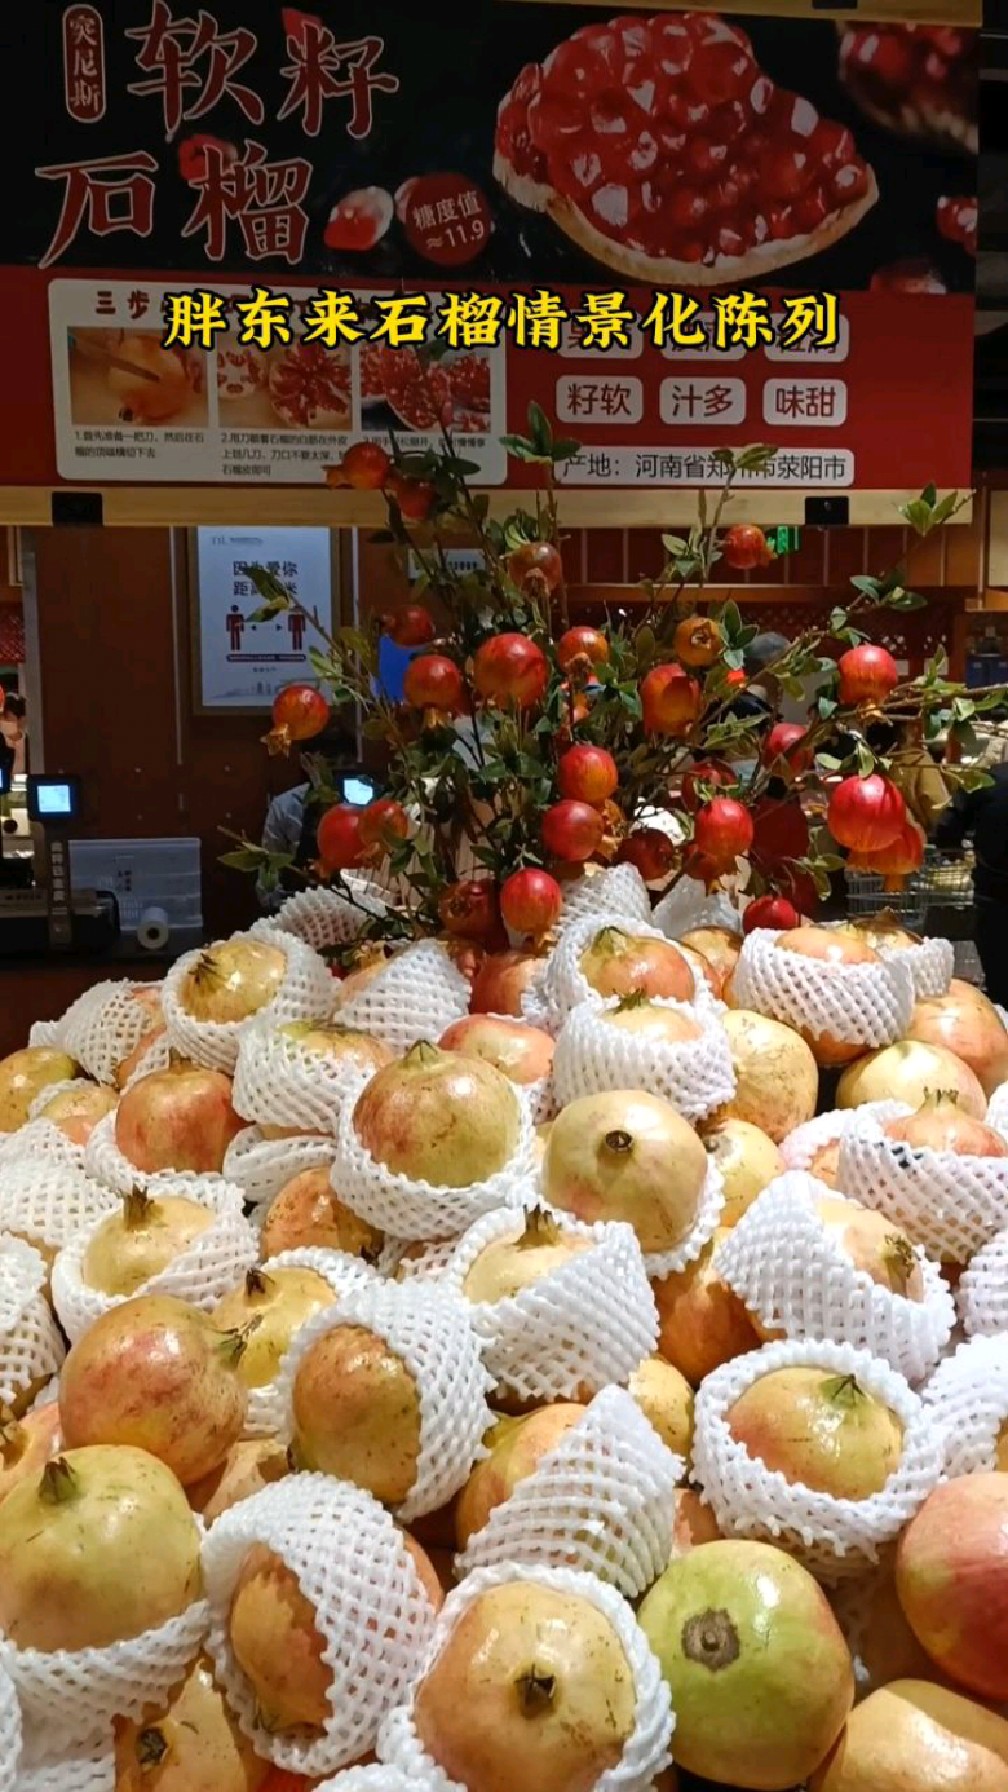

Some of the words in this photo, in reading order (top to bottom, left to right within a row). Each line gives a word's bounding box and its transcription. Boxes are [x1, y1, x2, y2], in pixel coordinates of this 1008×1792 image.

[69, 15, 101, 112] 突尼斯
[124, 0, 400, 141] 软籽
[35, 140, 314, 269] 石榴
[412, 190, 482, 231] 糖度值
[567, 384, 631, 416] 籽软
[672, 384, 733, 418] 汁多
[776, 385, 836, 418] 味甜
